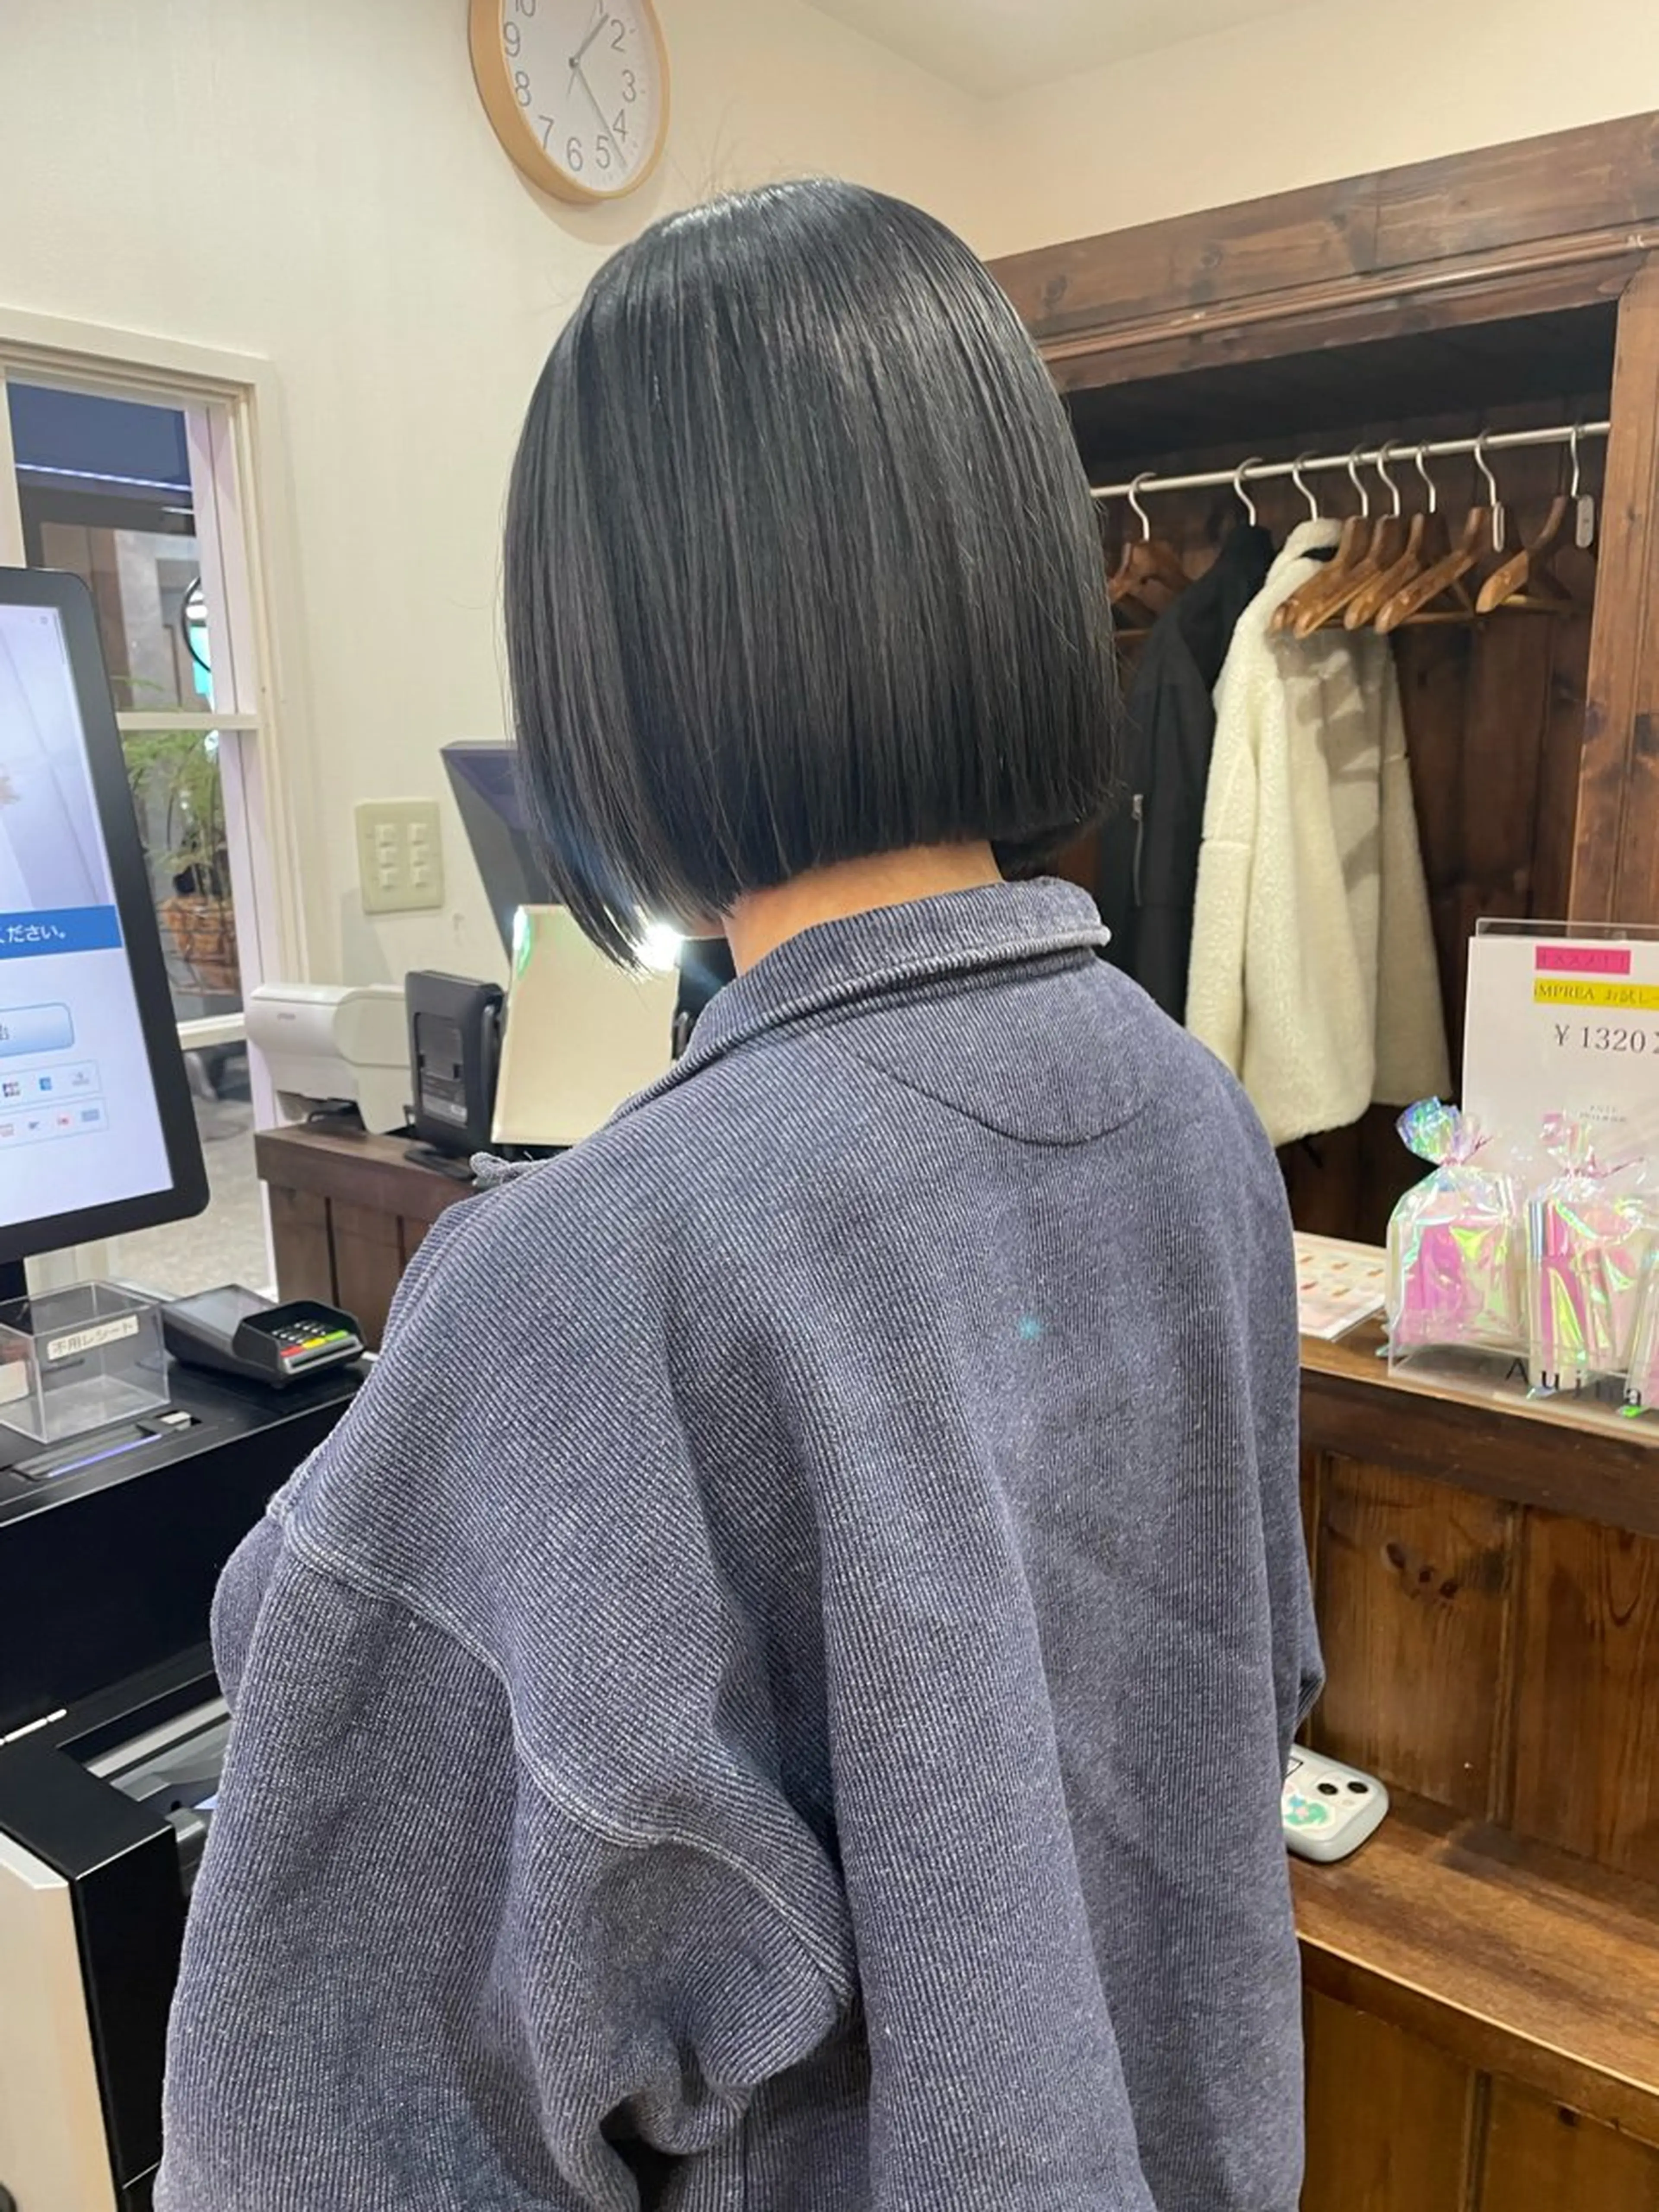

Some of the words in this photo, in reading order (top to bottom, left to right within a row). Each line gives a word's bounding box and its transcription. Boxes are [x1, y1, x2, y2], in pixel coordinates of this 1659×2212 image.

[503, 21, 520, 57] 9
[610, 19, 626, 52] 2
[515, 71, 531, 107] 8
[622, 69, 636, 102] 3
[538, 115, 554, 150] 7
[613, 109, 628, 142] 4
[566, 137, 583, 172] 6
[595, 135, 610, 169] 5
